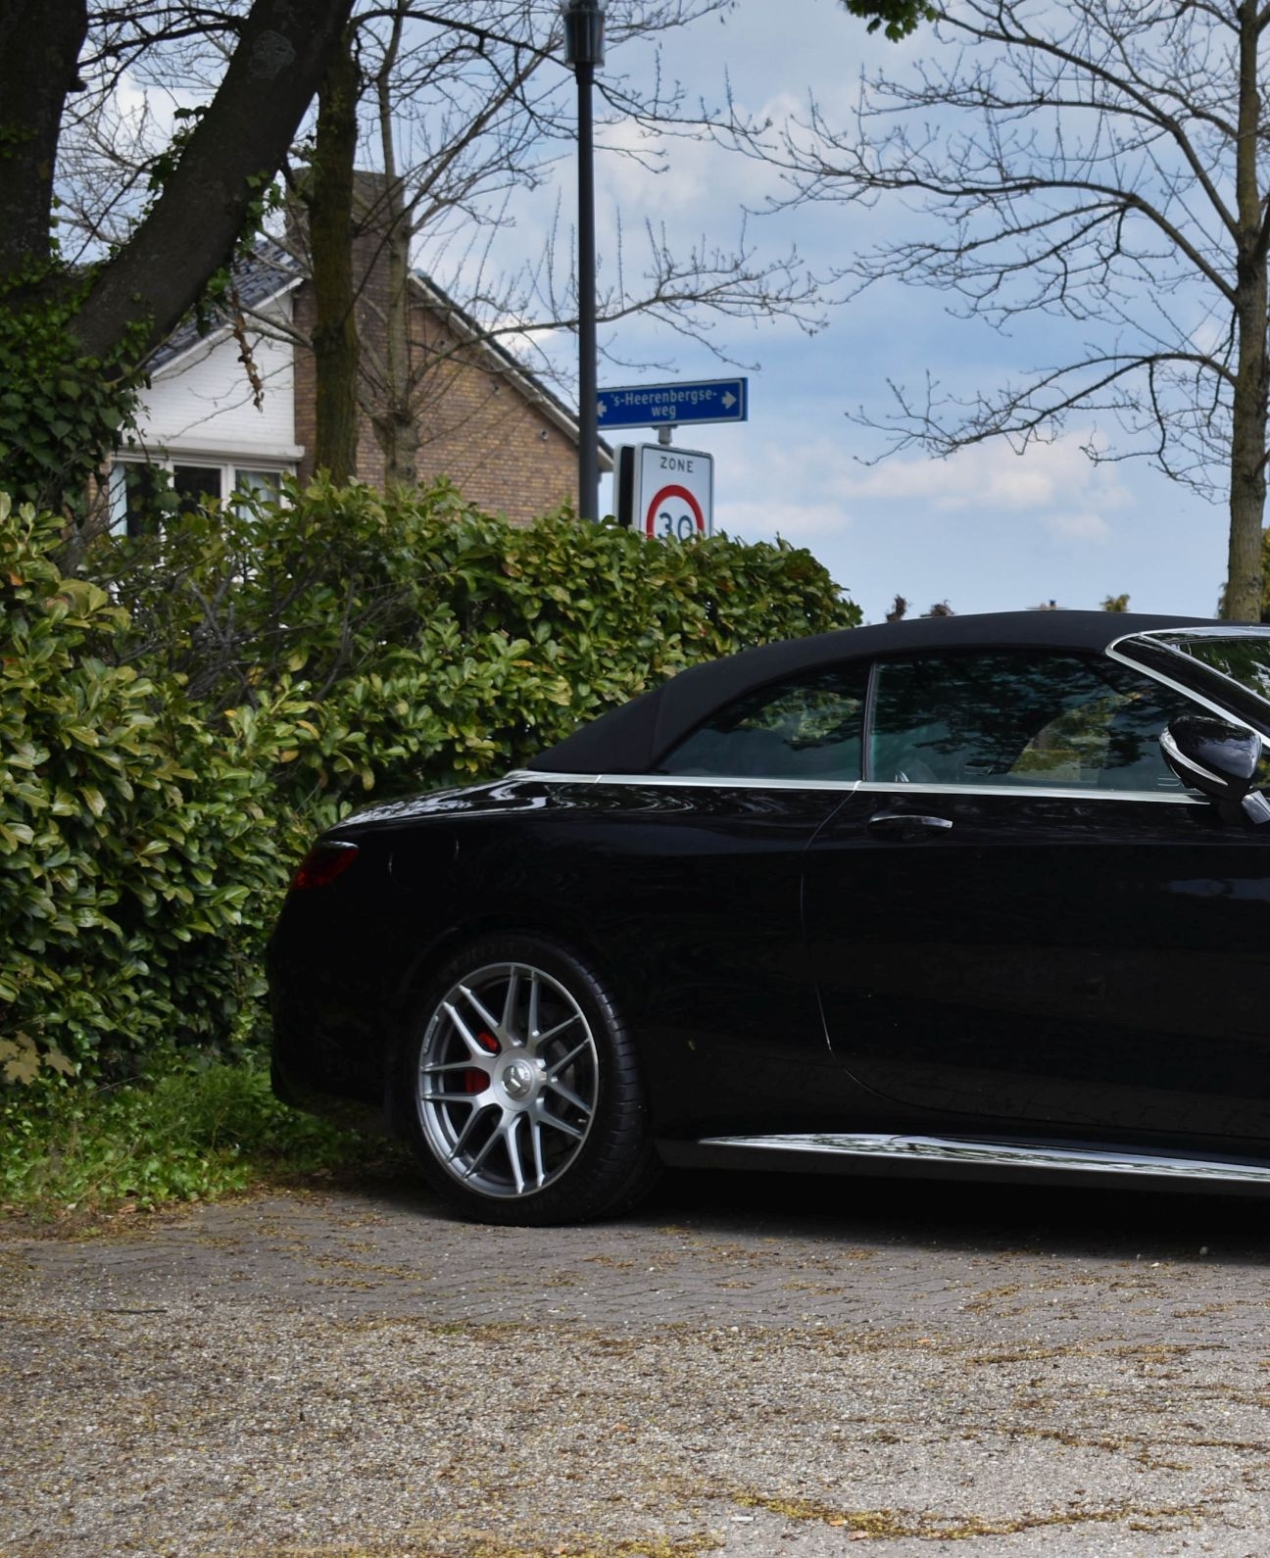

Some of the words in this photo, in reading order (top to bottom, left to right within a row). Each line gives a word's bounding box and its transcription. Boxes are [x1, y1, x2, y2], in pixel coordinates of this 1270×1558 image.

[611, 389, 718, 406] 's-Heerenbergse-
[651, 405, 676, 419] weg
[660, 456, 694, 474] ZONE
[658, 512, 694, 542] 30
